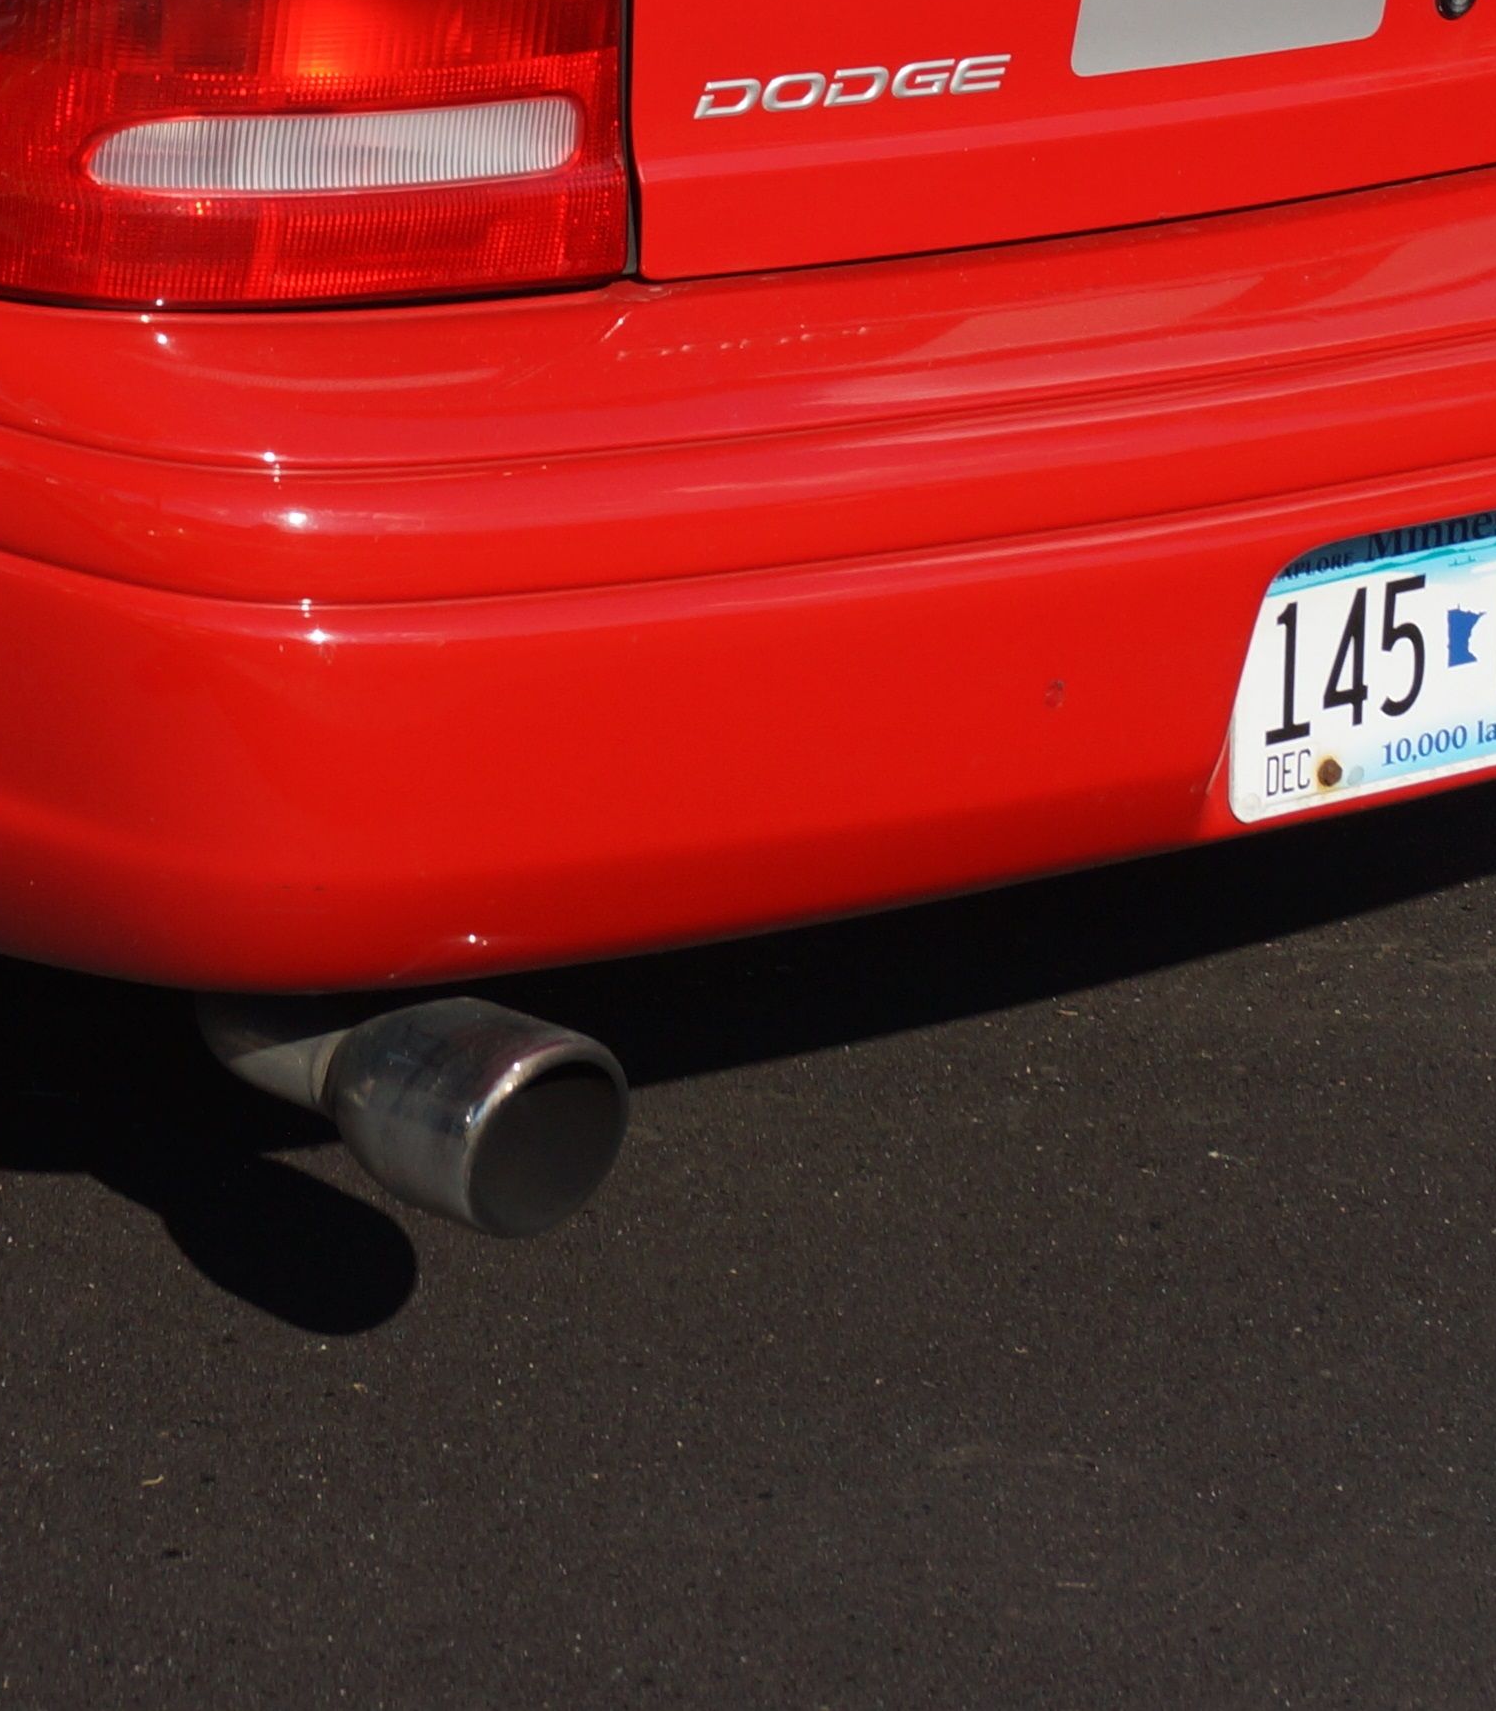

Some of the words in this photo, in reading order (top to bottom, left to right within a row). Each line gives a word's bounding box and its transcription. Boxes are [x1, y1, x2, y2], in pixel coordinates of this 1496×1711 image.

[693, 53, 1012, 121] DODGE
[1265, 574, 1427, 747] 145
[1266, 747, 1312, 798] DEC
[1381, 724, 1468, 768] 10,000
